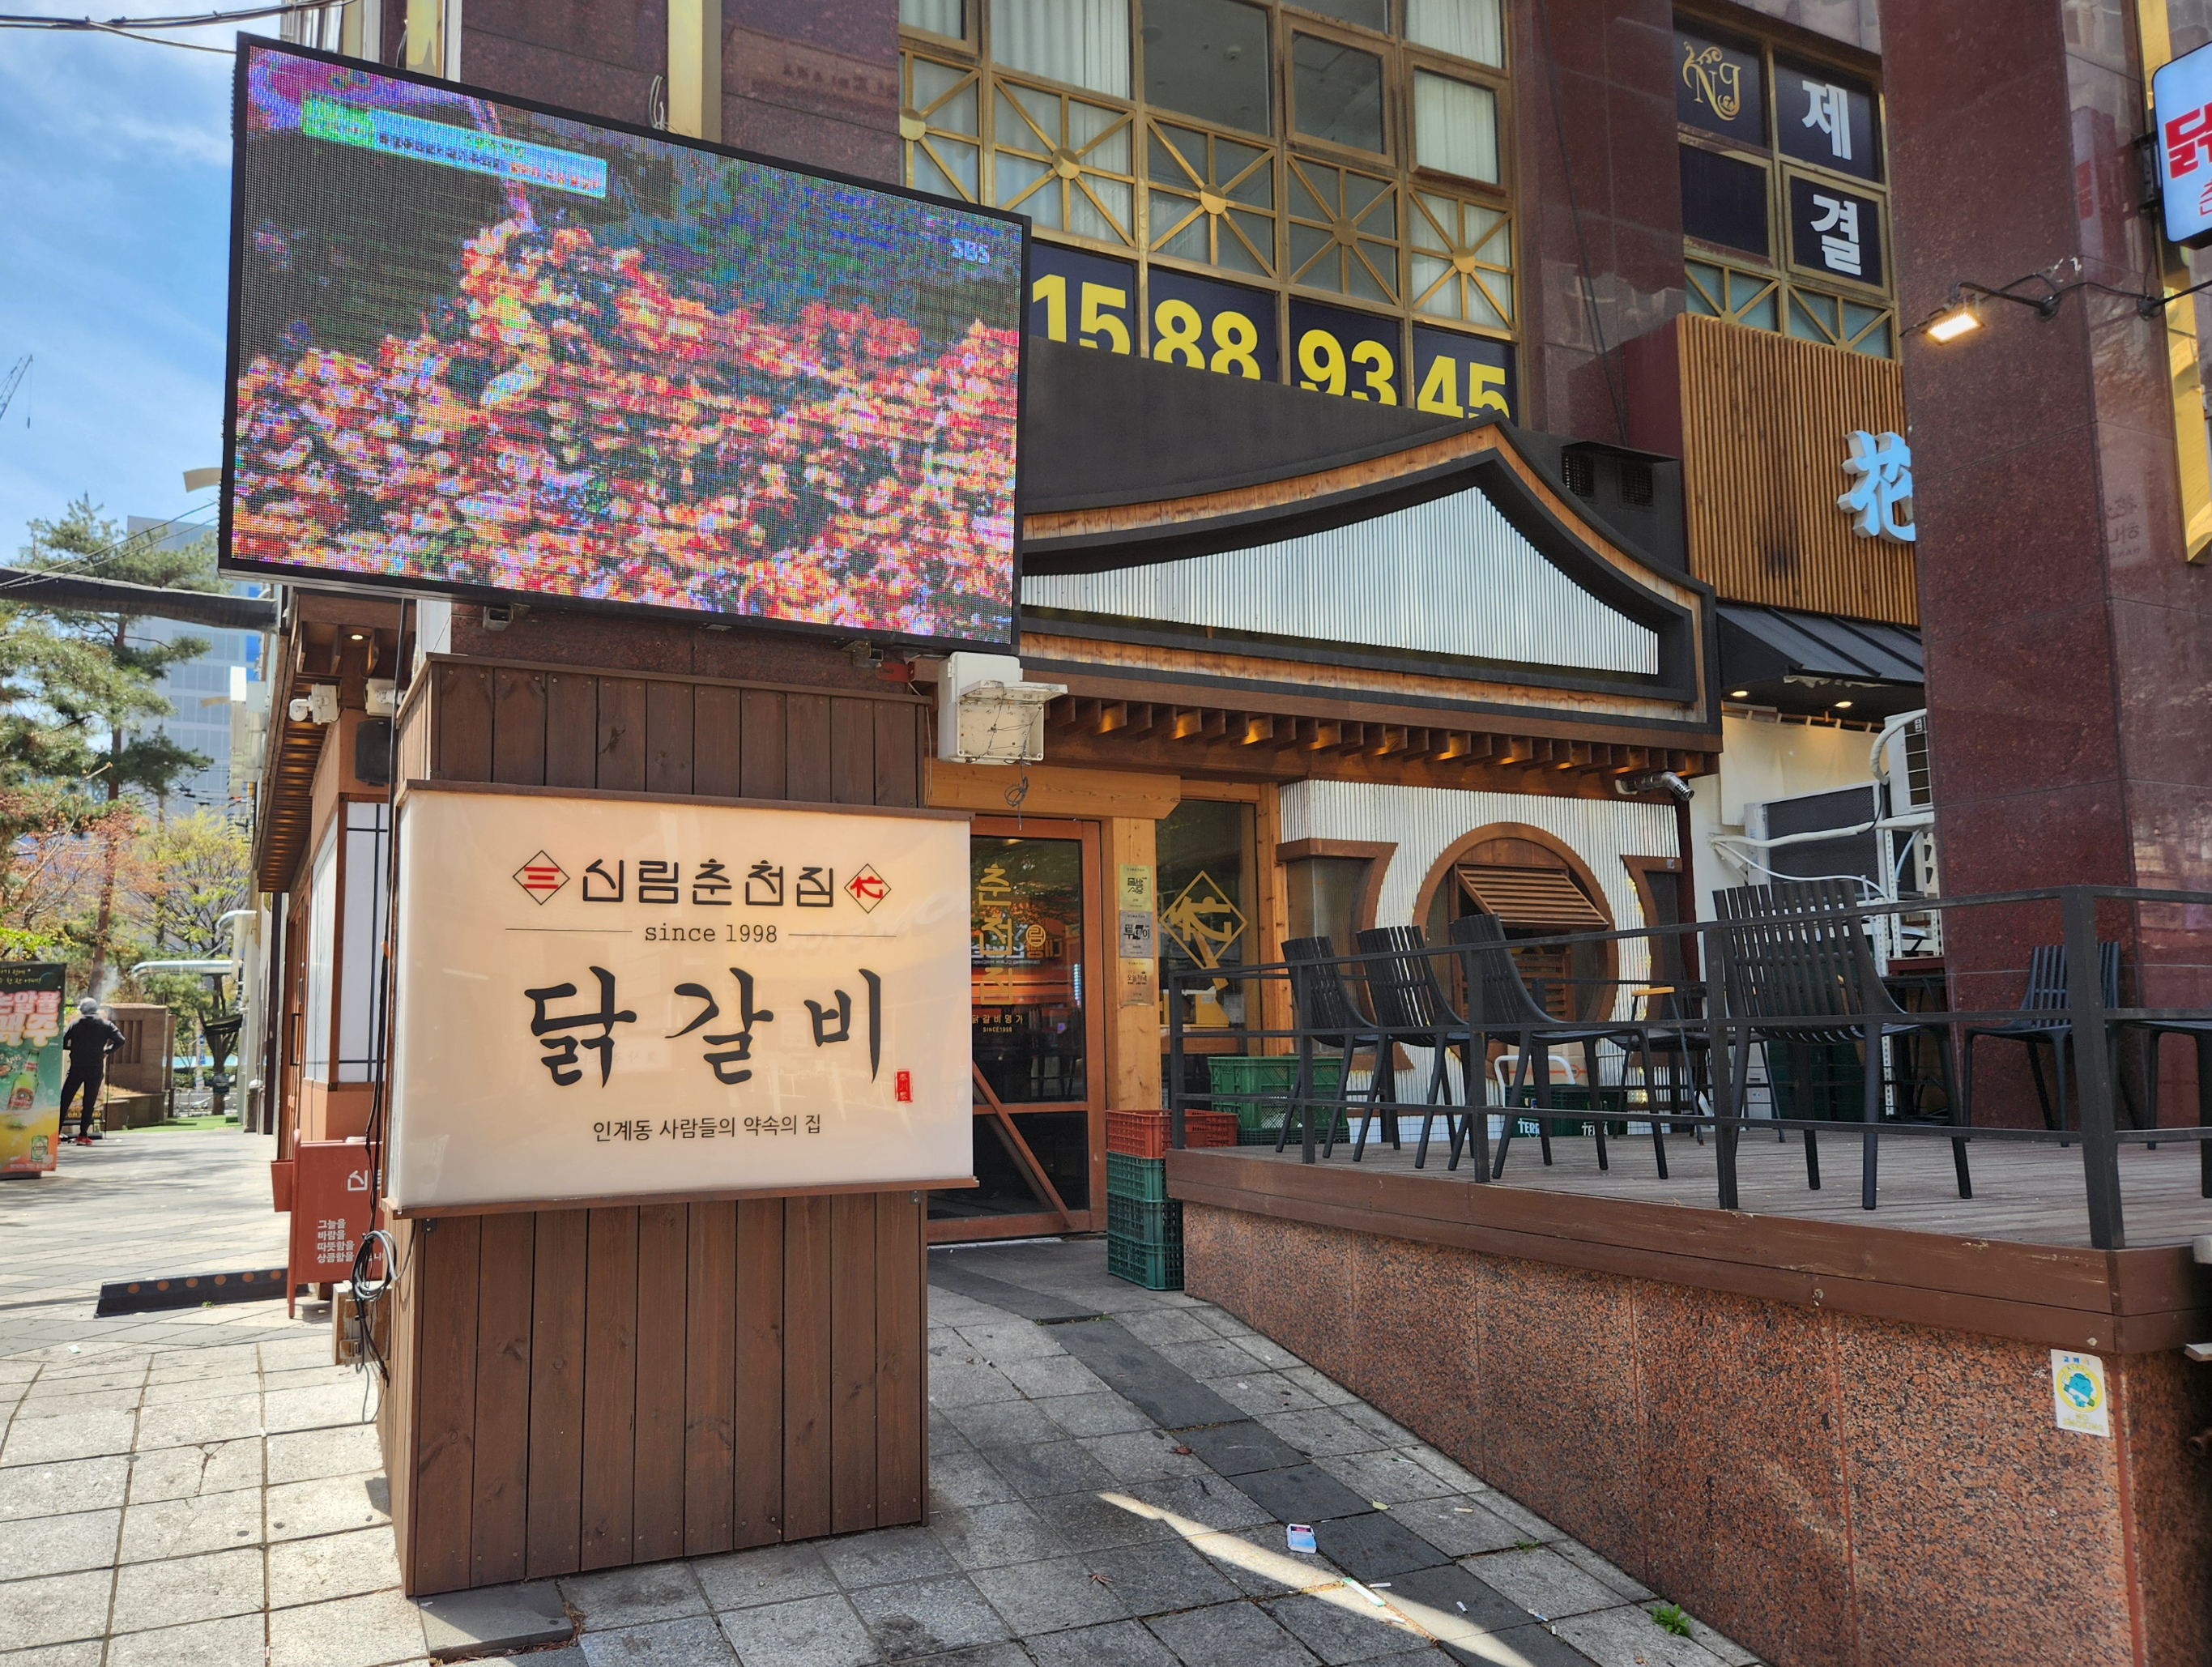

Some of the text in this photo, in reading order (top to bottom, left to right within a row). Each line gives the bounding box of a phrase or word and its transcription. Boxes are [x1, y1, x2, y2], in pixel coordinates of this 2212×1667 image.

[1802, 80, 1852, 161] 제
[1811, 194, 1862, 276] 결
[582, 859, 833, 908] 신림춘천집
[645, 922, 716, 943] since
[726, 924, 778, 944] 1998
[522, 965, 882, 1089] 닭갈비
[593, 1114, 820, 1142] 인계동 사람들의 약속의 집
[1517, 1120, 1541, 1135] TERR
[318, 1218, 346, 1230] 그늘을
[317, 1240, 355, 1251] 따뜻함을
[318, 1230, 346, 1241] 바람을
[317, 1251, 354, 1264] 상큼함을
